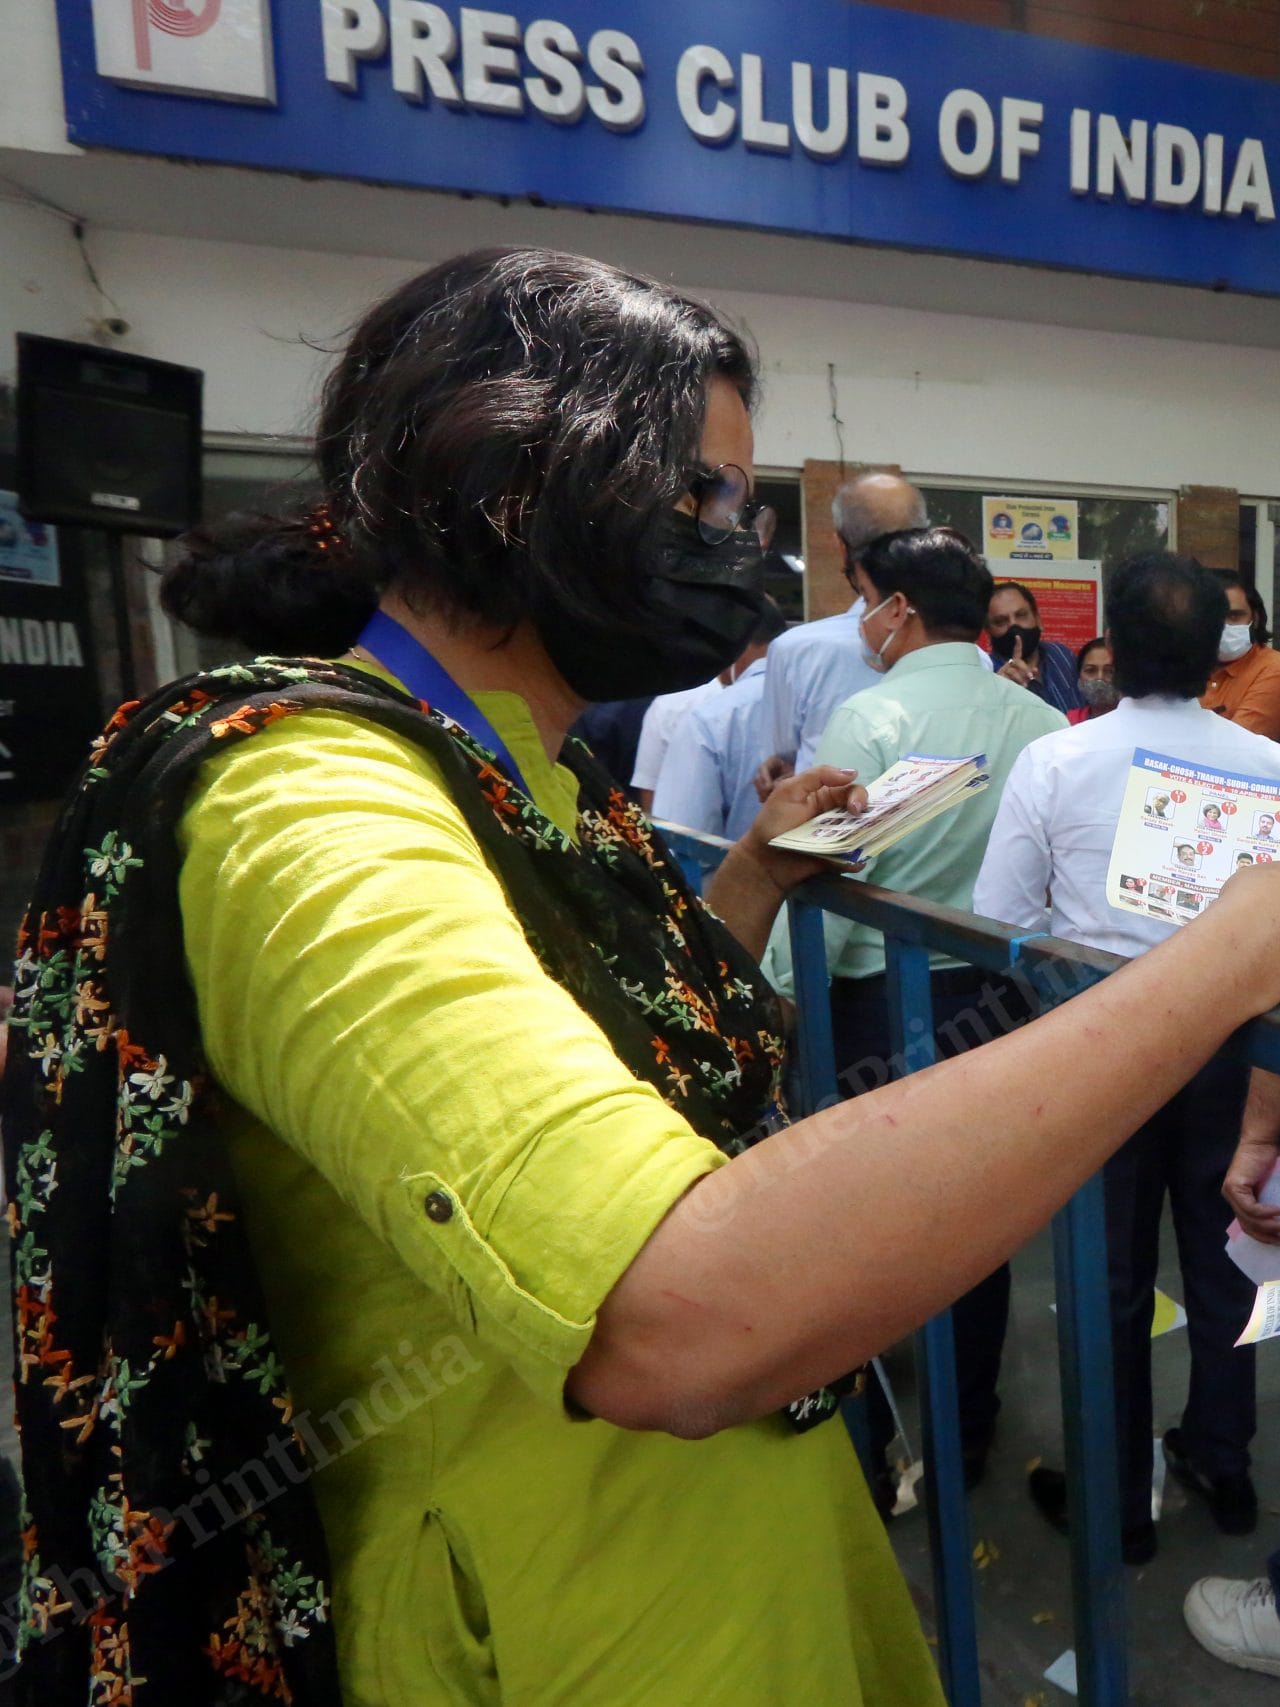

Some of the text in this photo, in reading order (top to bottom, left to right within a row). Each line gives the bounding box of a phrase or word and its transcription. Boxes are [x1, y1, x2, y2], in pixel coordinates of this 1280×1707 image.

[320, 0, 646, 132] PRESS
[676, 45, 911, 167] CLUB
[939, 89, 1043, 183] OF
[1070, 109, 1275, 223] INDIA
